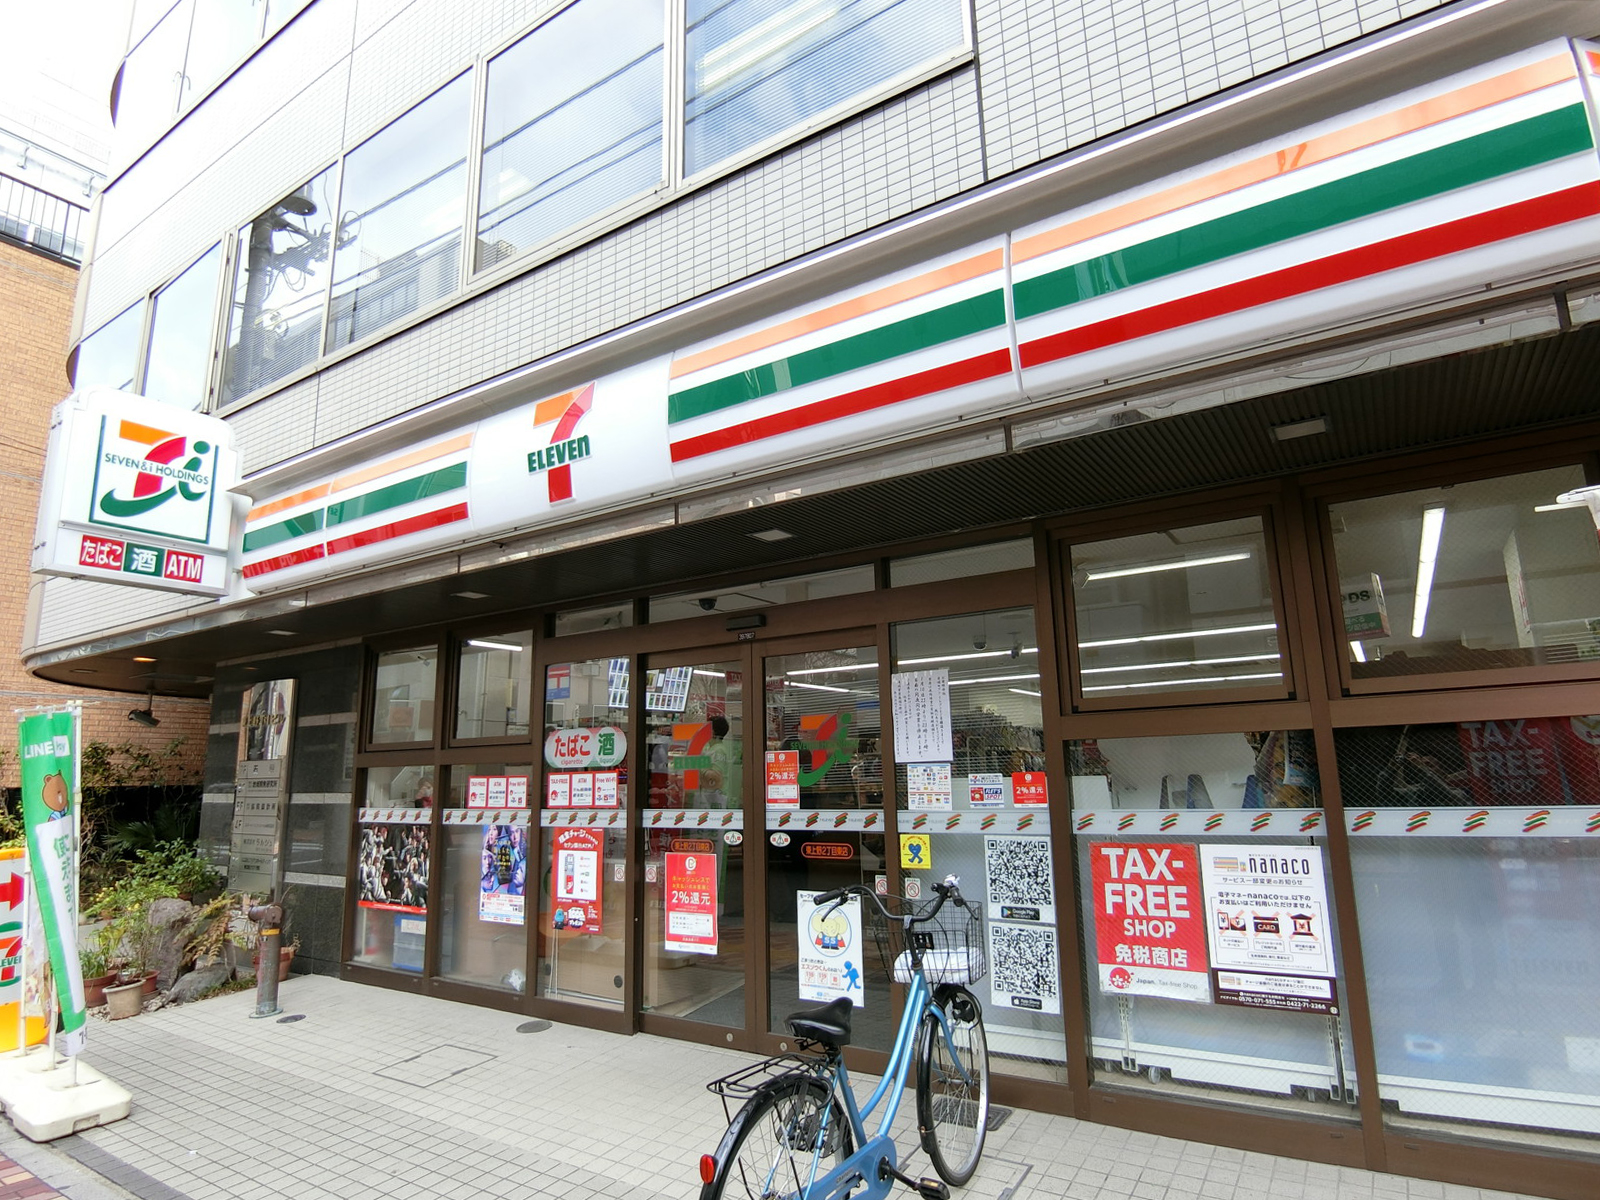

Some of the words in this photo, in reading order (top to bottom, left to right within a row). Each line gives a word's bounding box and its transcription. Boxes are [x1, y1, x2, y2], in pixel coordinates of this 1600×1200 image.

[156, 465, 209, 485] HOLDINGS
[81, 540, 122, 566] たばこ
[131, 547, 158, 573] 酒
[166, 554, 202, 580] ATM
[1340, 590, 1370, 603] DS
[24, 741, 54, 759] LINE
[555, 734, 591, 758] たばこ
[598, 732, 615, 756] 酒
[561, 758, 583, 766] cigarette
[770, 772, 795, 780] 2%還元
[1016, 786, 1044, 794] 2%還元
[1101, 847, 1184, 881] TAX-
[1249, 857, 1310, 875] nanaco
[1222, 877, 1302, 885] サービス一部変更のお知らせ
[672, 890, 711, 905] 2%還元
[1104, 882, 1190, 918] FREE
[1219, 899, 1312, 909] お支払いはご利用いただけません
[1123, 918, 1176, 939] SHOP
[1114, 943, 1188, 968] 免税商店
[1183, 981, 1198, 990] Shop
[1238, 996, 1277, 1005] 0570-071-555
[1286, 1001, 1327, 1010] 0422-71-2266
